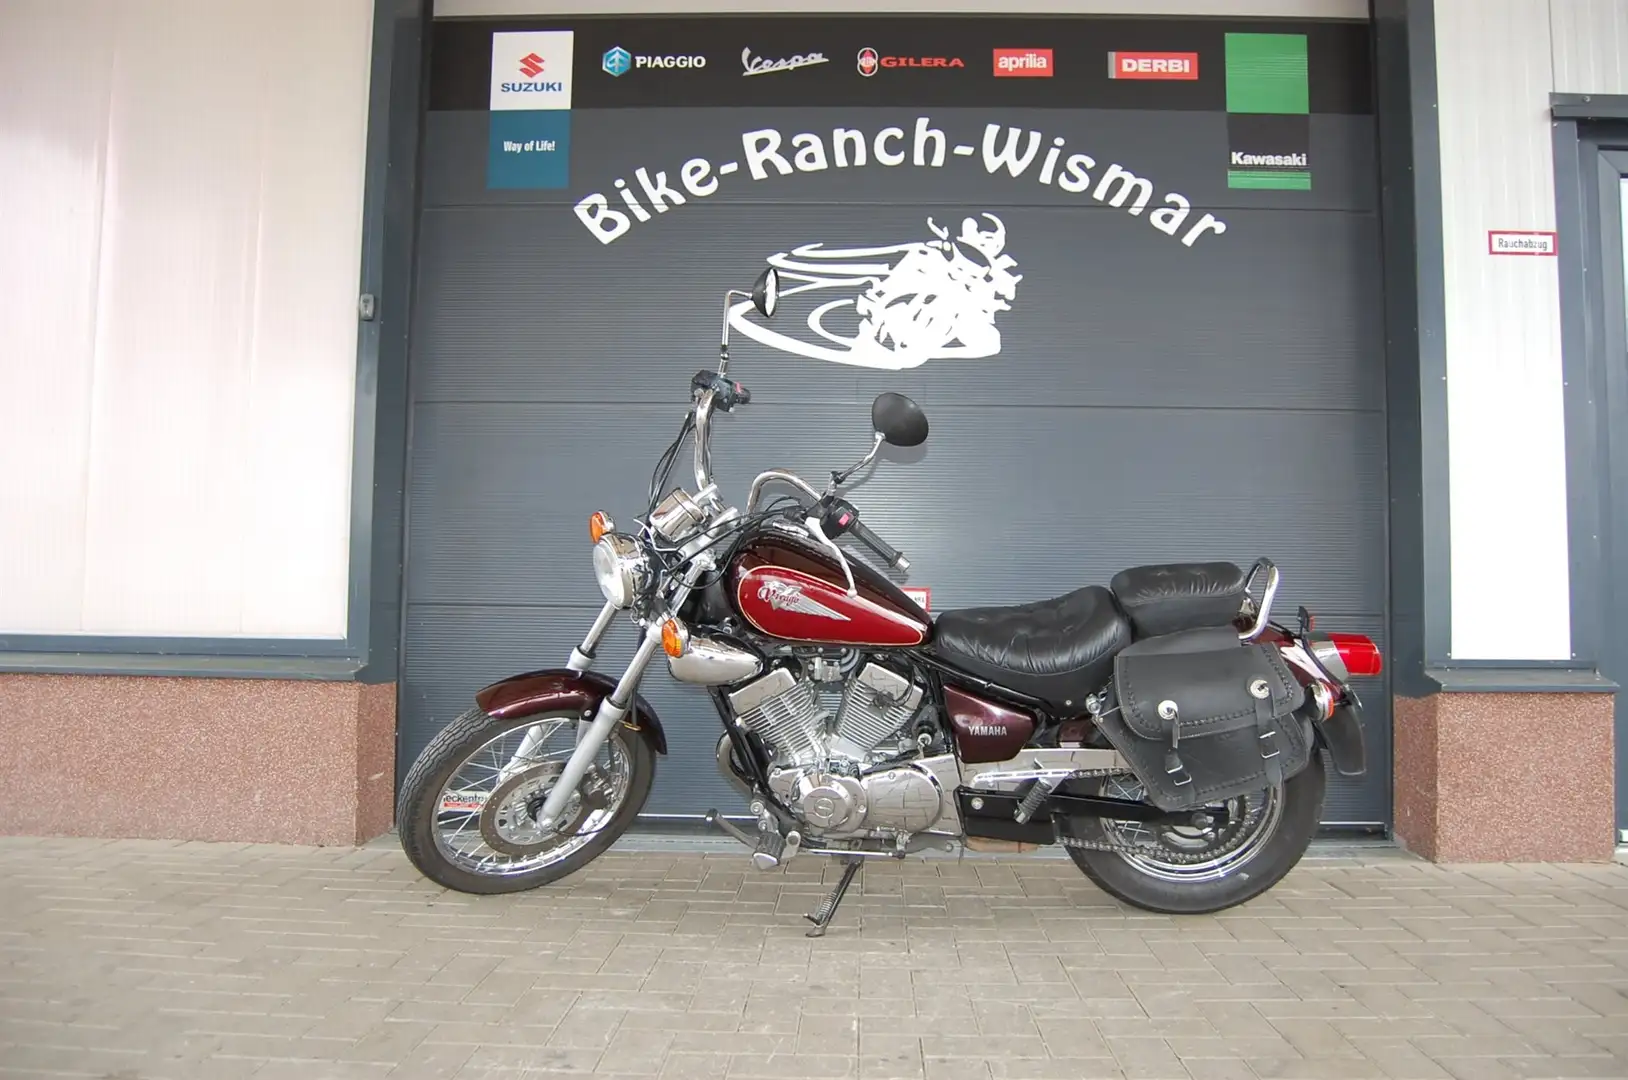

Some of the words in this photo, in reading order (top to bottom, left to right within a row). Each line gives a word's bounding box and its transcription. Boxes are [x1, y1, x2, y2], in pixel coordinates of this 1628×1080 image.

[635, 56, 706, 68] PIAGGIO
[741, 47, 829, 76] Vespa
[880, 56, 964, 67] GILERA
[998, 53, 1047, 71] aprilia
[1122, 59, 1189, 73] DERBI
[501, 82, 562, 92] SUZUKI
[503, 141, 522, 153] Way
[524, 141, 534, 151] of
[536, 141, 555, 151] Life!
[1231, 152, 1307, 166] Kawasaki
[1498, 238, 1547, 251] Rauchabzug
[968, 726, 1007, 736] YAMAHA
